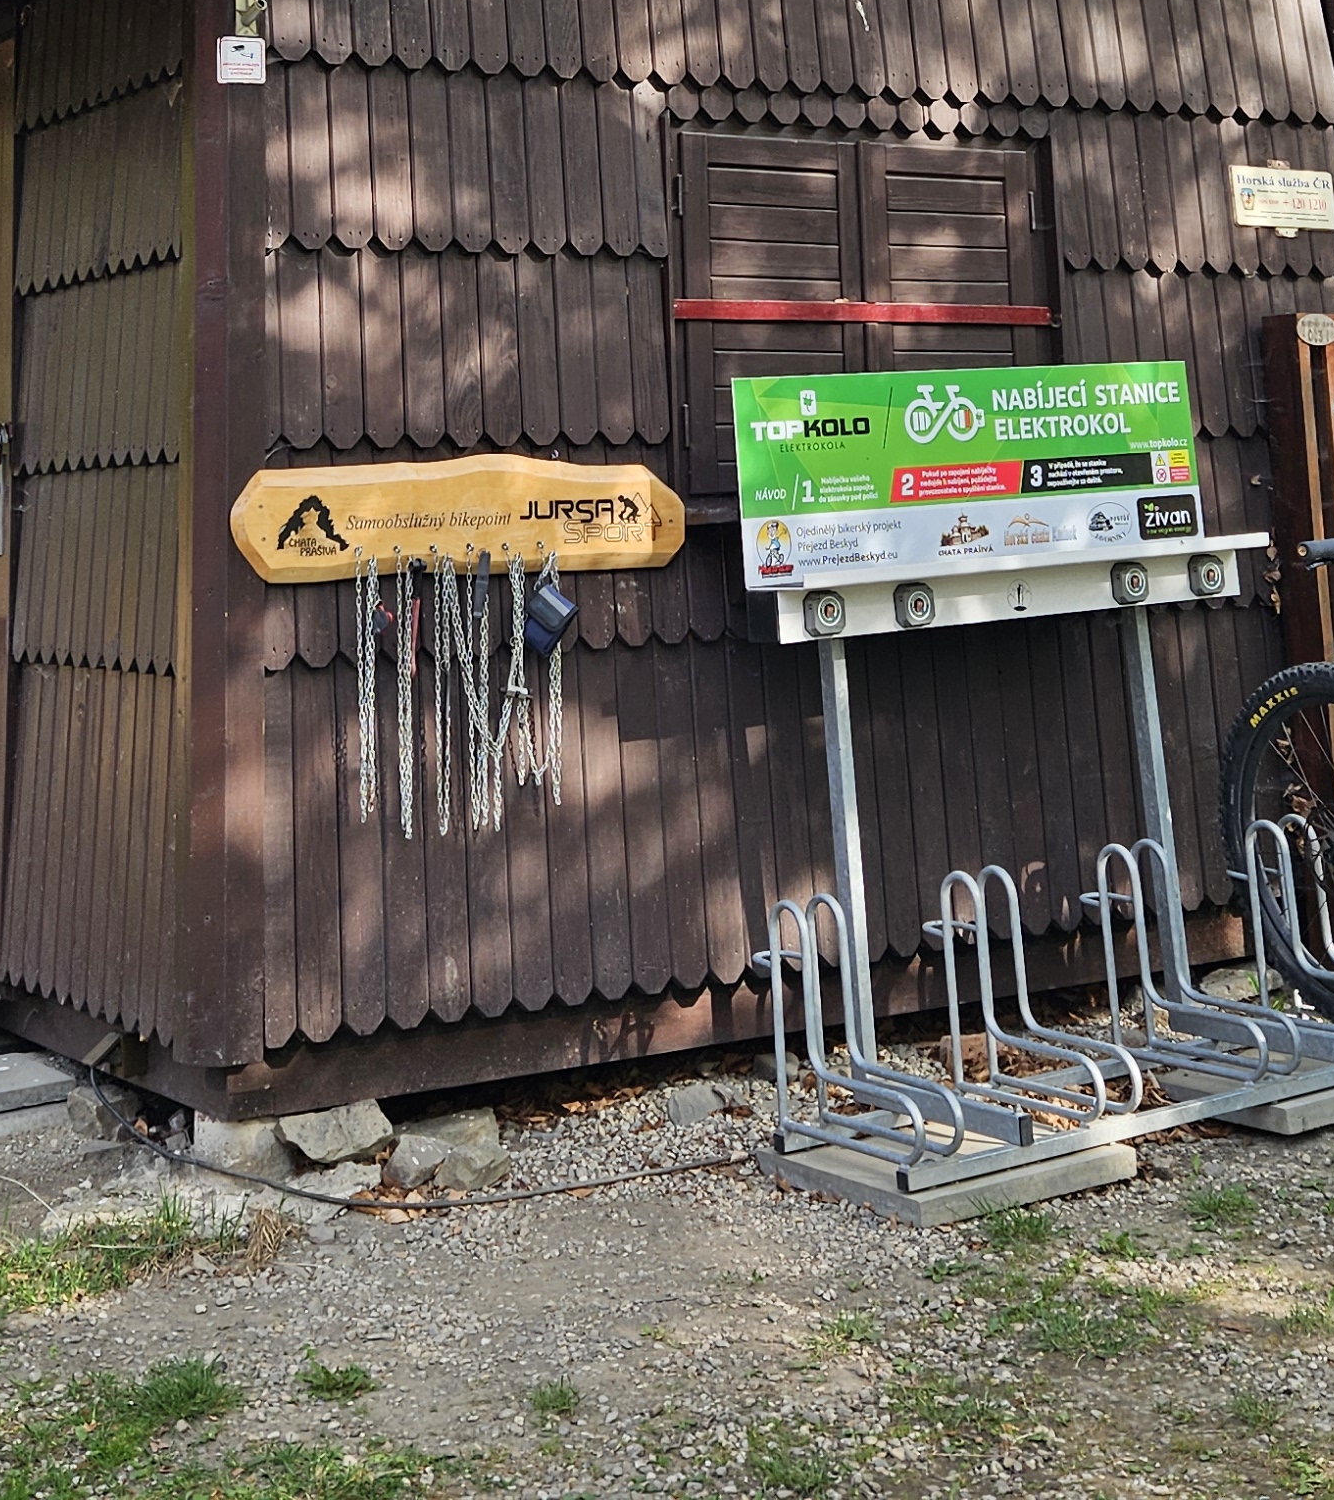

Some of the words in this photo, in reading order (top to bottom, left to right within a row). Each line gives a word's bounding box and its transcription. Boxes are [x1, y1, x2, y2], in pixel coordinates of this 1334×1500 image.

[1237, 175, 1274, 186] Horská
[1278, 177, 1309, 188] služba
[1313, 178, 1330, 189] ČR
[991, 379, 1088, 411] NABÍJECÍ
[1095, 381, 1180, 407] STANICE
[750, 417, 871, 441] TOPKOLO
[994, 412, 1131, 441] ELEKTROKOL
[780, 441, 845, 453] ELEKTROKOLA
[1129, 437, 1188, 450] www.topkolo.cz
[901, 473, 914, 496] 2
[1030, 465, 1043, 488] 3
[755, 487, 787, 501] NÁVOD
[802, 480, 815, 503] 1
[346, 512, 445, 531] Samoobslužný
[449, 511, 512, 530] bikepoint
[520, 499, 614, 524] JURSA
[796, 524, 836, 539] Ojedinělý
[838, 521, 871, 535] bikerský
[873, 519, 902, 533] projekt
[288, 538, 317, 547] CHATA
[830, 538, 858, 550] Beskyd
[938, 548, 961, 556] CHATA
[1249, 686, 1299, 728] MAXXIS
